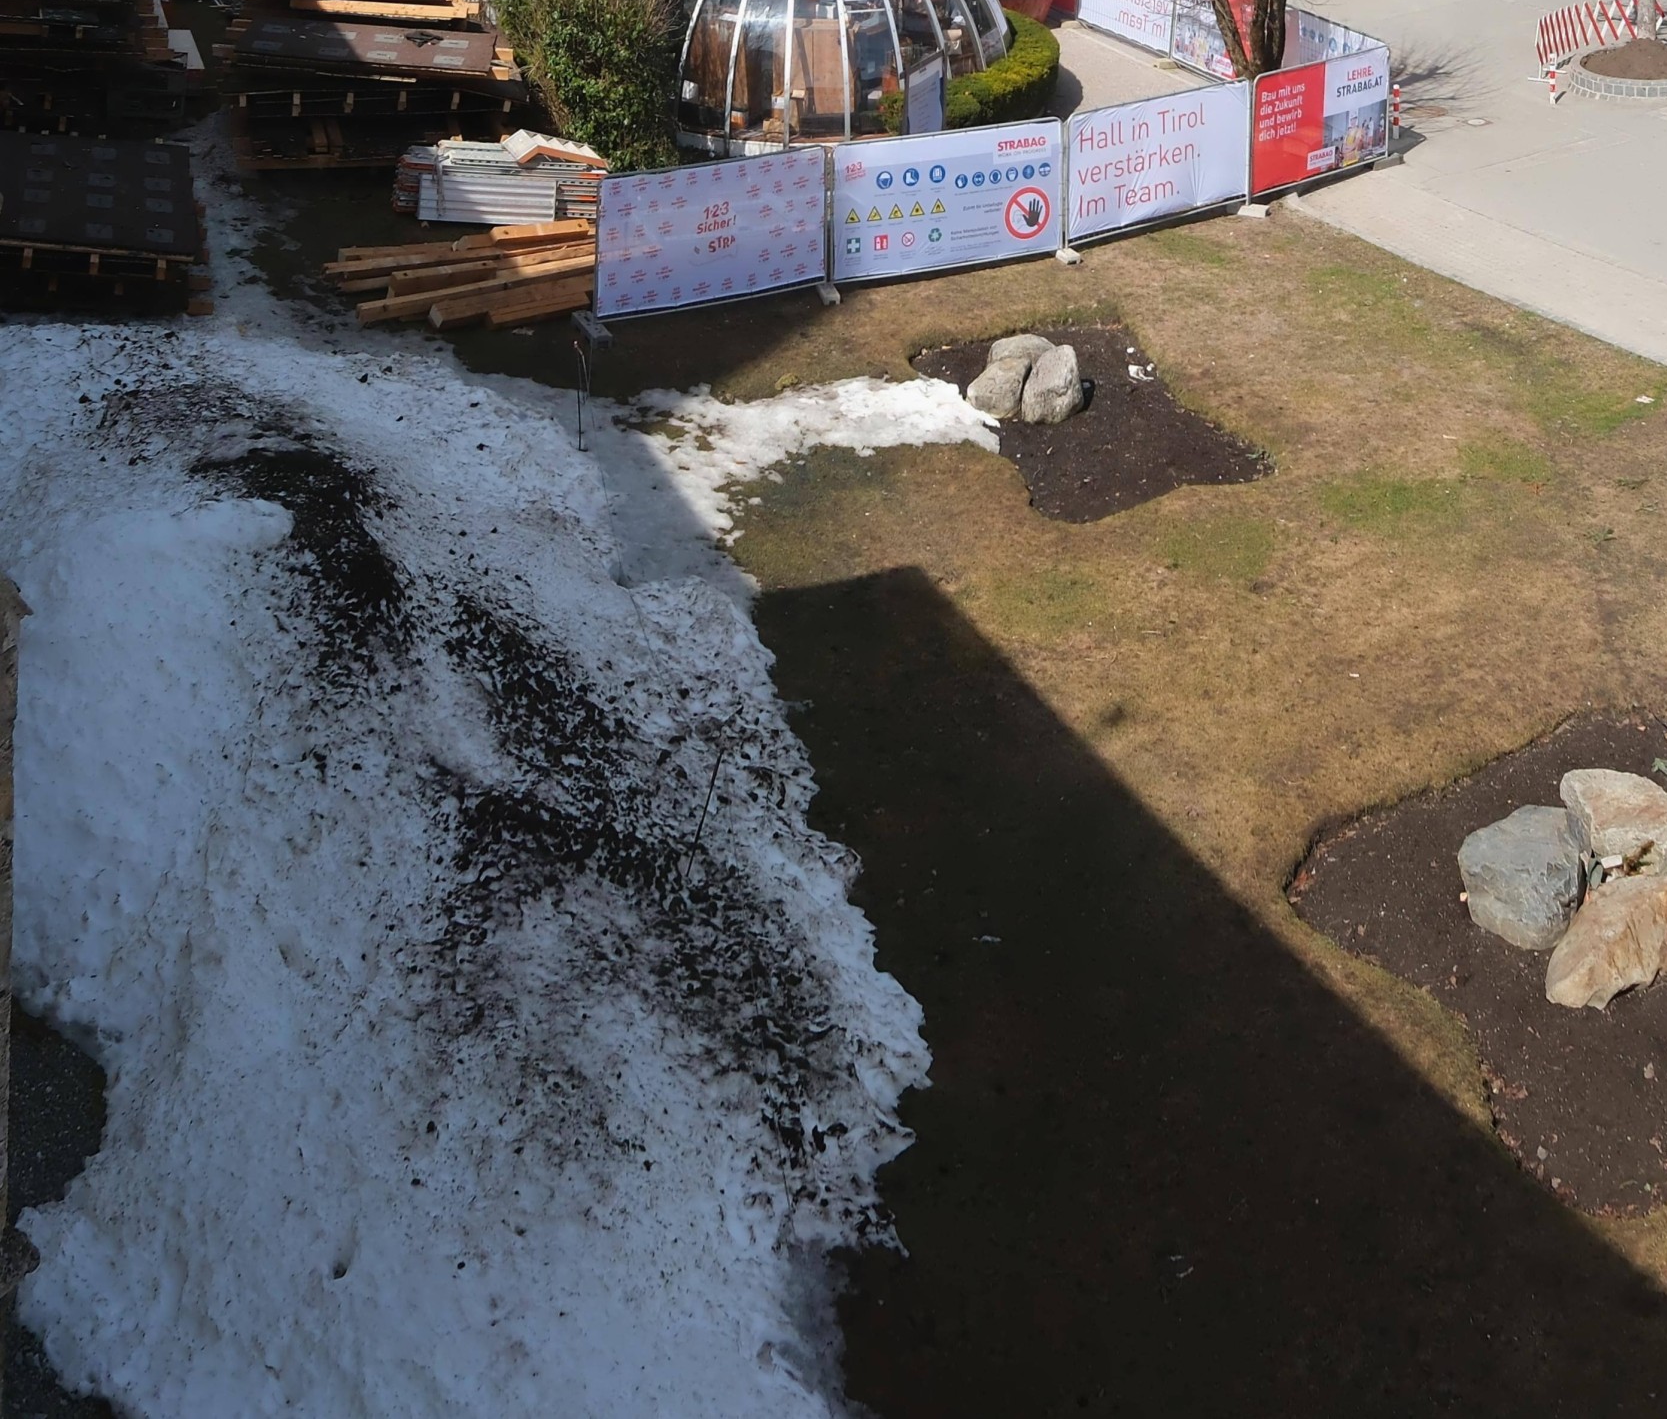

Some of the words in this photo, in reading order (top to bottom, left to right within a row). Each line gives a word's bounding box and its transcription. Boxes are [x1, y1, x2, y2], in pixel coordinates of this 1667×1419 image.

[1347, 66, 1374, 81] LEHRE.
[1261, 91, 1277, 102] Bau
[1278, 86, 1291, 97] mit
[1292, 83, 1305, 94] uns
[1336, 76, 1383, 98] STRABAG.AT
[1260, 104, 1273, 116] die
[1274, 95, 1303, 112] Zukunft
[1078, 121, 1124, 153] Hall
[1131, 118, 1149, 141] in
[1157, 102, 1205, 135] Tirol
[1259, 117, 1275, 129] und
[1276, 109, 1303, 124] bewirb
[997, 136, 1047, 152] STRABAG
[1259, 129, 1275, 142] dich
[1078, 143, 1201, 185] verstärken.
[1078, 195, 1106, 219] Im
[1114, 180, 1180, 209] Team.
[696, 214, 737, 234] Sicher!
